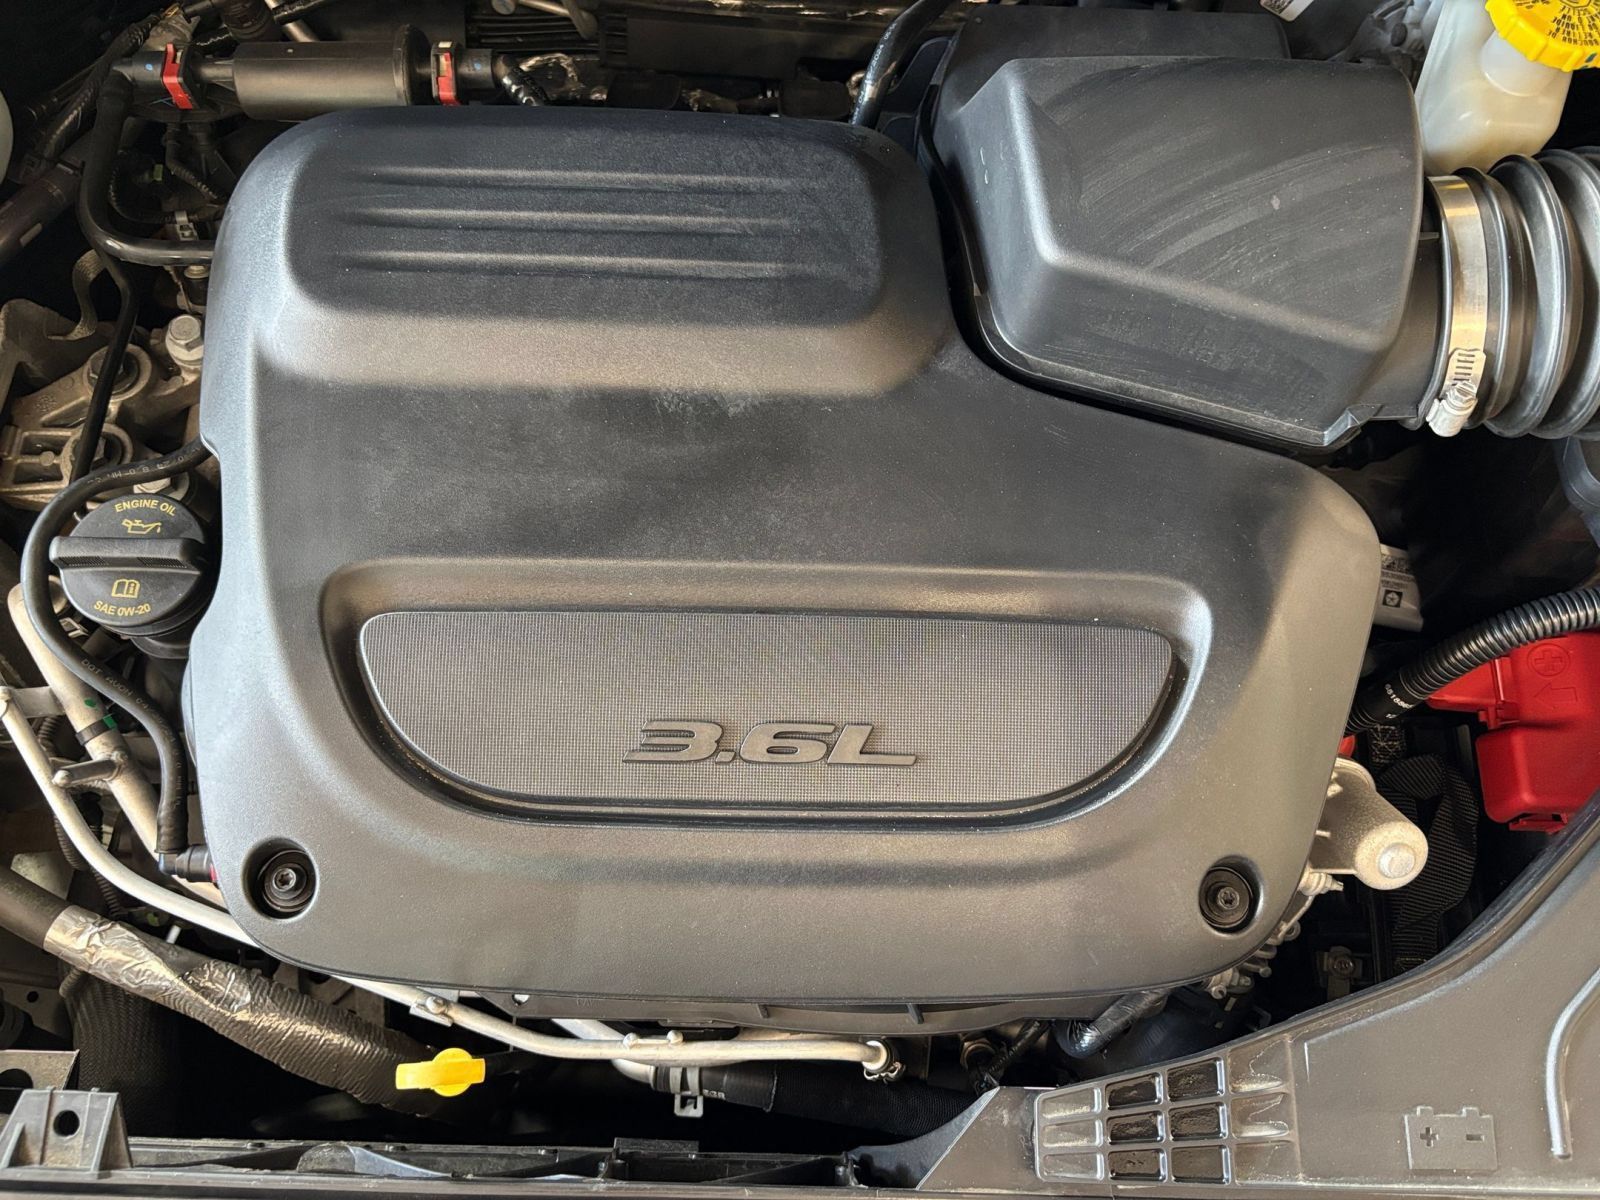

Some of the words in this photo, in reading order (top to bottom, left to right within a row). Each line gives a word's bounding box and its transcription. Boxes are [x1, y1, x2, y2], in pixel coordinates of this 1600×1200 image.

[115, 499, 159, 513] ENGINE
[160, 502, 177, 517] OIL
[94, 600, 115, 616] SAE
[117, 603, 151, 617] 0W-20
[622, 719, 917, 766] 3.6L
